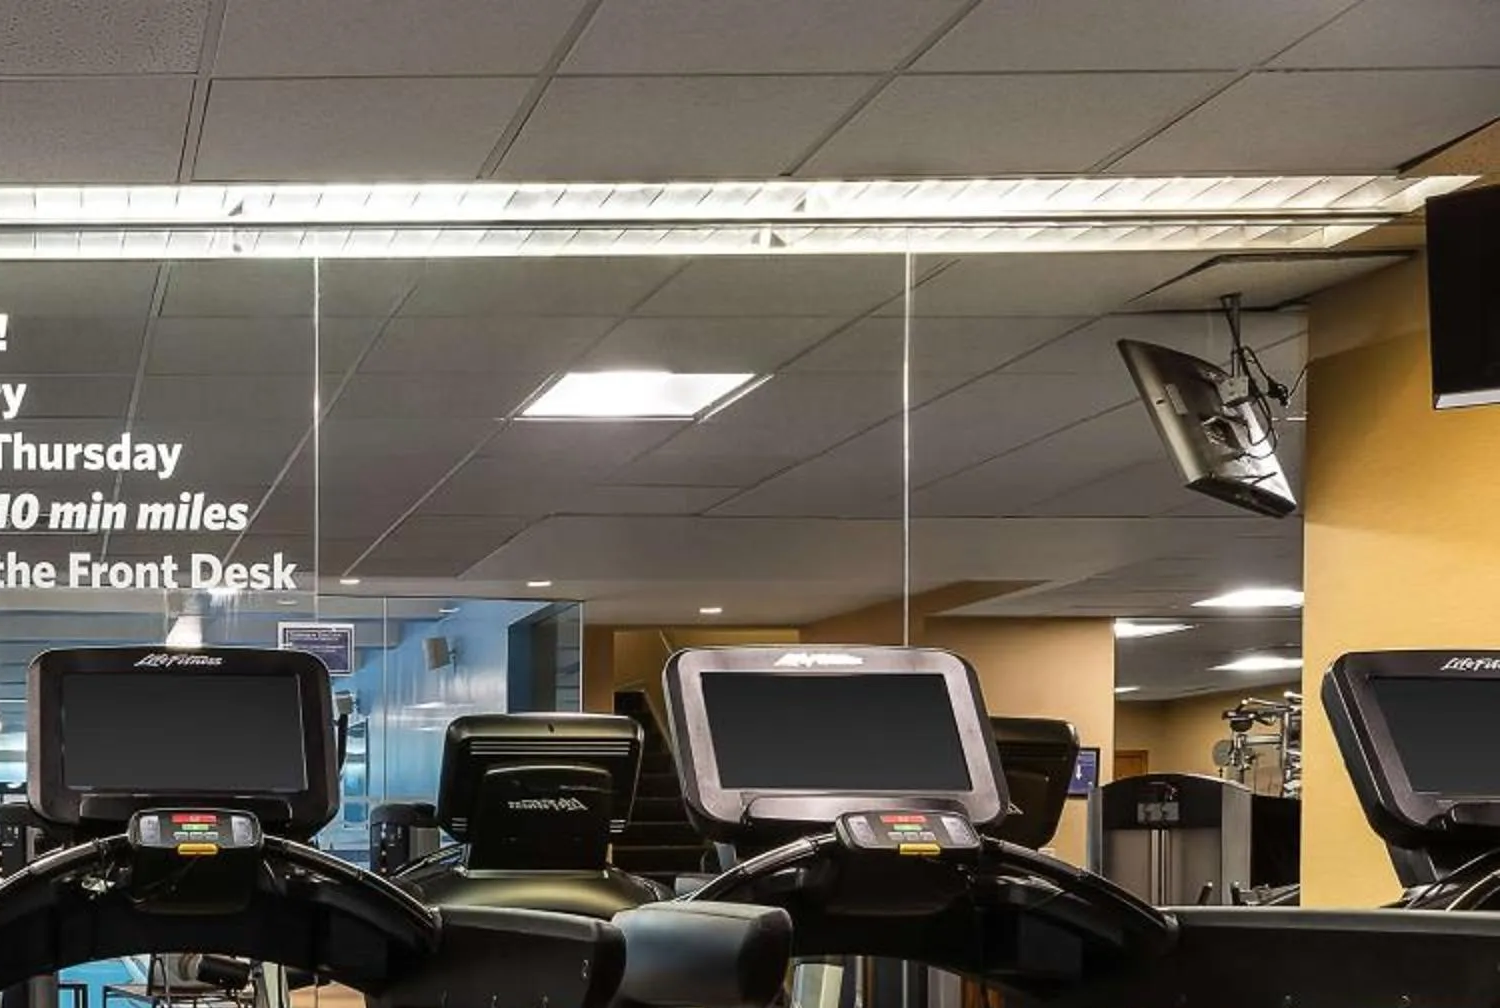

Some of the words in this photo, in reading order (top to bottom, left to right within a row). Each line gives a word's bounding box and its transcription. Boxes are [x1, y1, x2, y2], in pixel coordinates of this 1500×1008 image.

[48, 491, 127, 530] min
[136, 491, 250, 530] miles
[69, 552, 178, 589] Front
[191, 552, 297, 589] Desk
